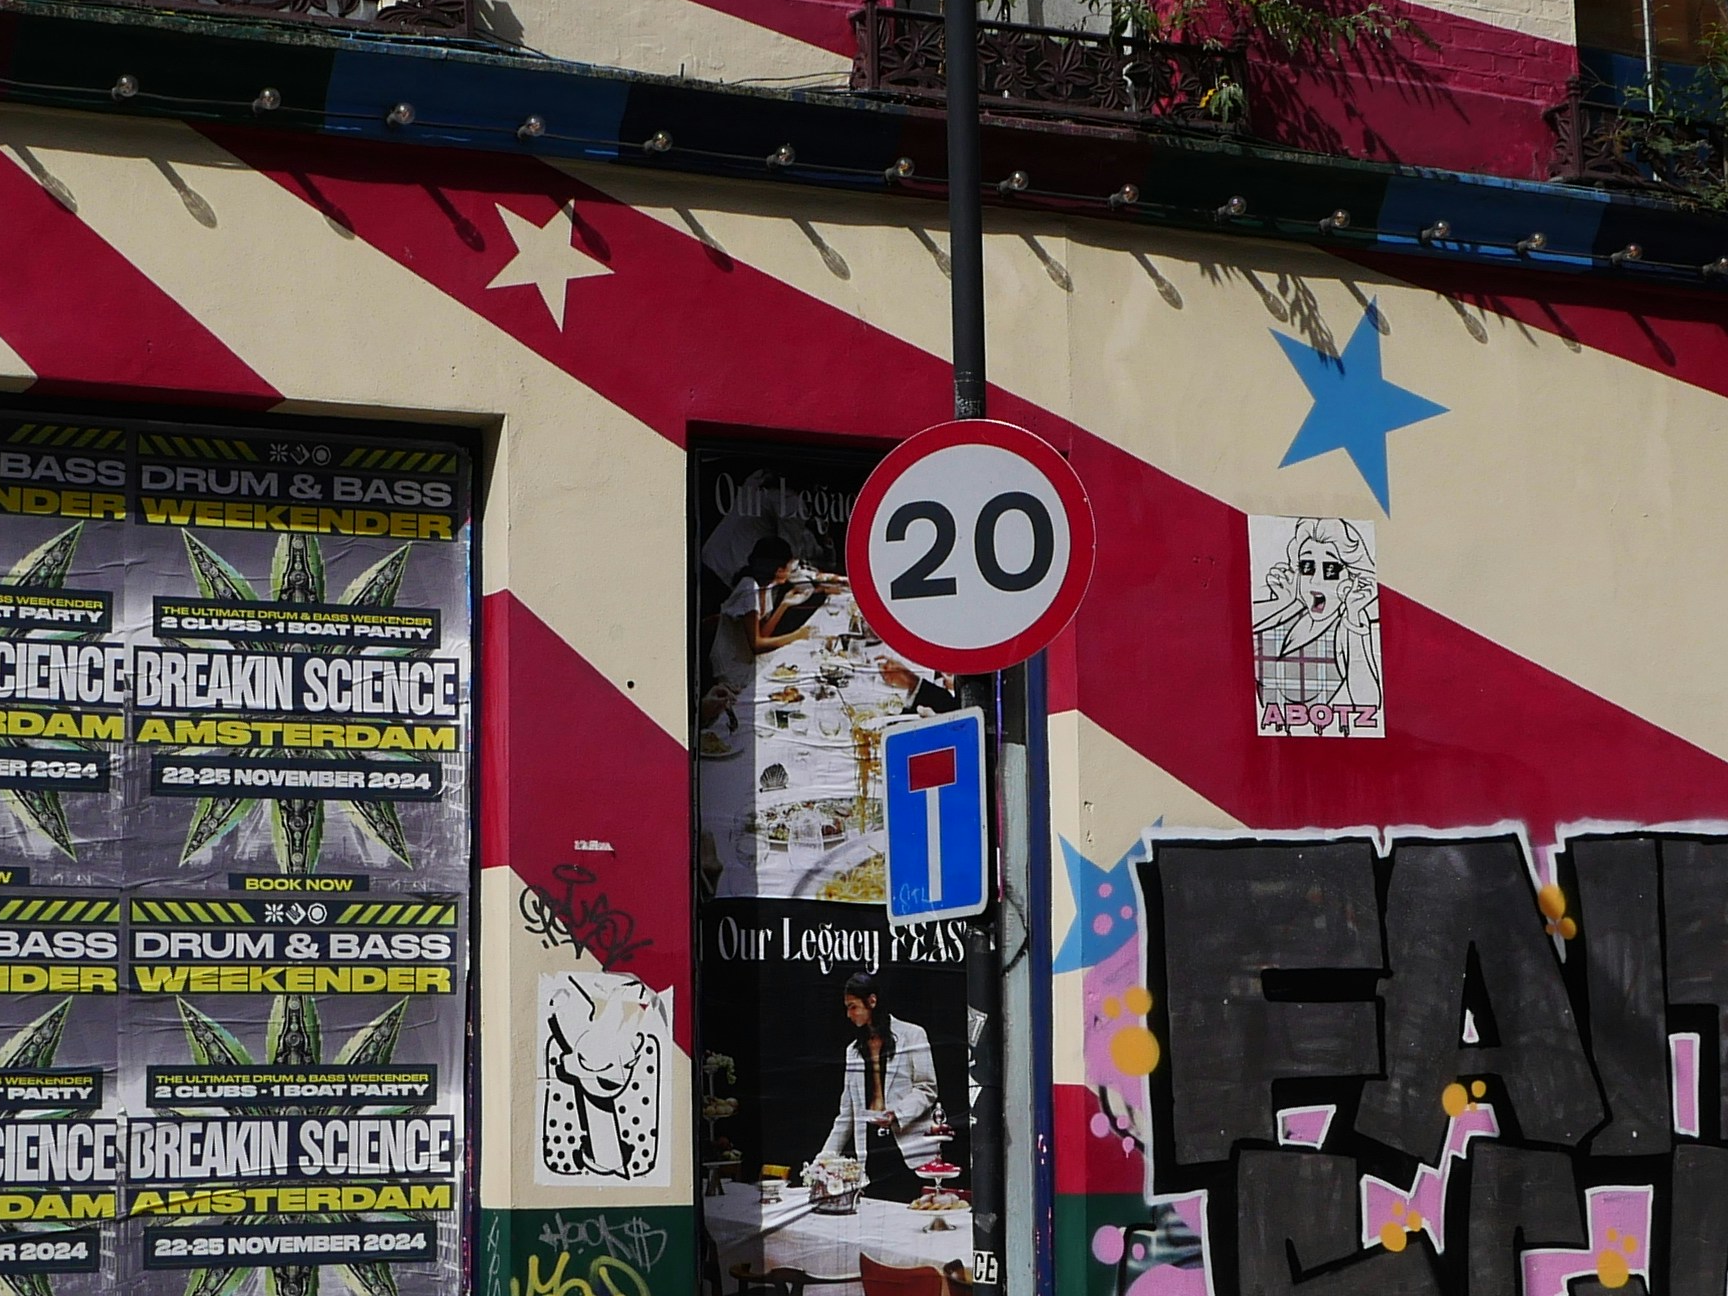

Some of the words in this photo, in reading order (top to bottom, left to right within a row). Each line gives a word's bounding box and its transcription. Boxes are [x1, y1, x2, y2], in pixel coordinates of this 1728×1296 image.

[0, 452, 126, 486] BASS
[141, 465, 278, 497] DRUM
[289, 474, 322, 500] &
[333, 477, 452, 507] BASS
[715, 472, 769, 518] Our
[779, 477, 859, 535] Legac
[141, 497, 452, 540] WEEKENDER
[885, 491, 1054, 601] 20
[12, 595, 103, 609] WEEKENDER
[19, 607, 104, 623] PARTY
[161, 606, 190, 616] THE
[191, 607, 256, 619] ULTIMATE
[258, 609, 298, 621] DRUM
[300, 612, 311, 621] &
[312, 612, 349, 623] BASS
[349, 614, 432, 626] WEEKENDER
[161, 616, 178, 629] 2
[180, 618, 263, 632] CLUBS
[354, 624, 433, 640] PARTY
[137, 651, 294, 711] BREAKIN
[303, 658, 455, 717] SCIENCE
[1261, 703, 1378, 737] ABOTZ
[136, 718, 455, 750] AMSTERDAM
[30, 760, 98, 779] 2024
[162, 767, 231, 785] 22-25
[234, 768, 365, 788] NOVEMBER
[368, 772, 431, 790] 2024
[245, 877, 302, 891] BOOK
[305, 878, 353, 891] NOW
[134, 932, 275, 959] DRUM
[284, 933, 320, 959] &
[329, 933, 452, 959] BASS
[718, 916, 773, 962] Our
[781, 917, 880, 975] Legacy
[889, 921, 967, 963] FEAS
[134, 966, 452, 992] WEEKENDER
[4, 1076, 93, 1086] WEEKENDER
[154, 1085, 172, 1098] 2
[174, 1085, 258, 1098] CLUBS
[350, 1084, 429, 1097] PARTY
[155, 1074, 183, 1084] THE
[185, 1074, 251, 1084] ULTIMATE
[253, 1074, 295, 1083] DRUM
[297, 1074, 307, 1083] &
[308, 1074, 346, 1083] BASS
[347, 1073, 429, 1083] WEEKENDER
[8, 1087, 93, 1100] PARTY
[130, 1119, 288, 1179] BREAKIN
[299, 1118, 452, 1175] SCIENCE
[130, 1185, 452, 1215] AMSTERDAM
[20, 1242, 88, 1261] 2024
[154, 1238, 224, 1256] 22-25
[228, 1235, 361, 1254] NOVEMBER
[363, 1233, 427, 1251] 2024
